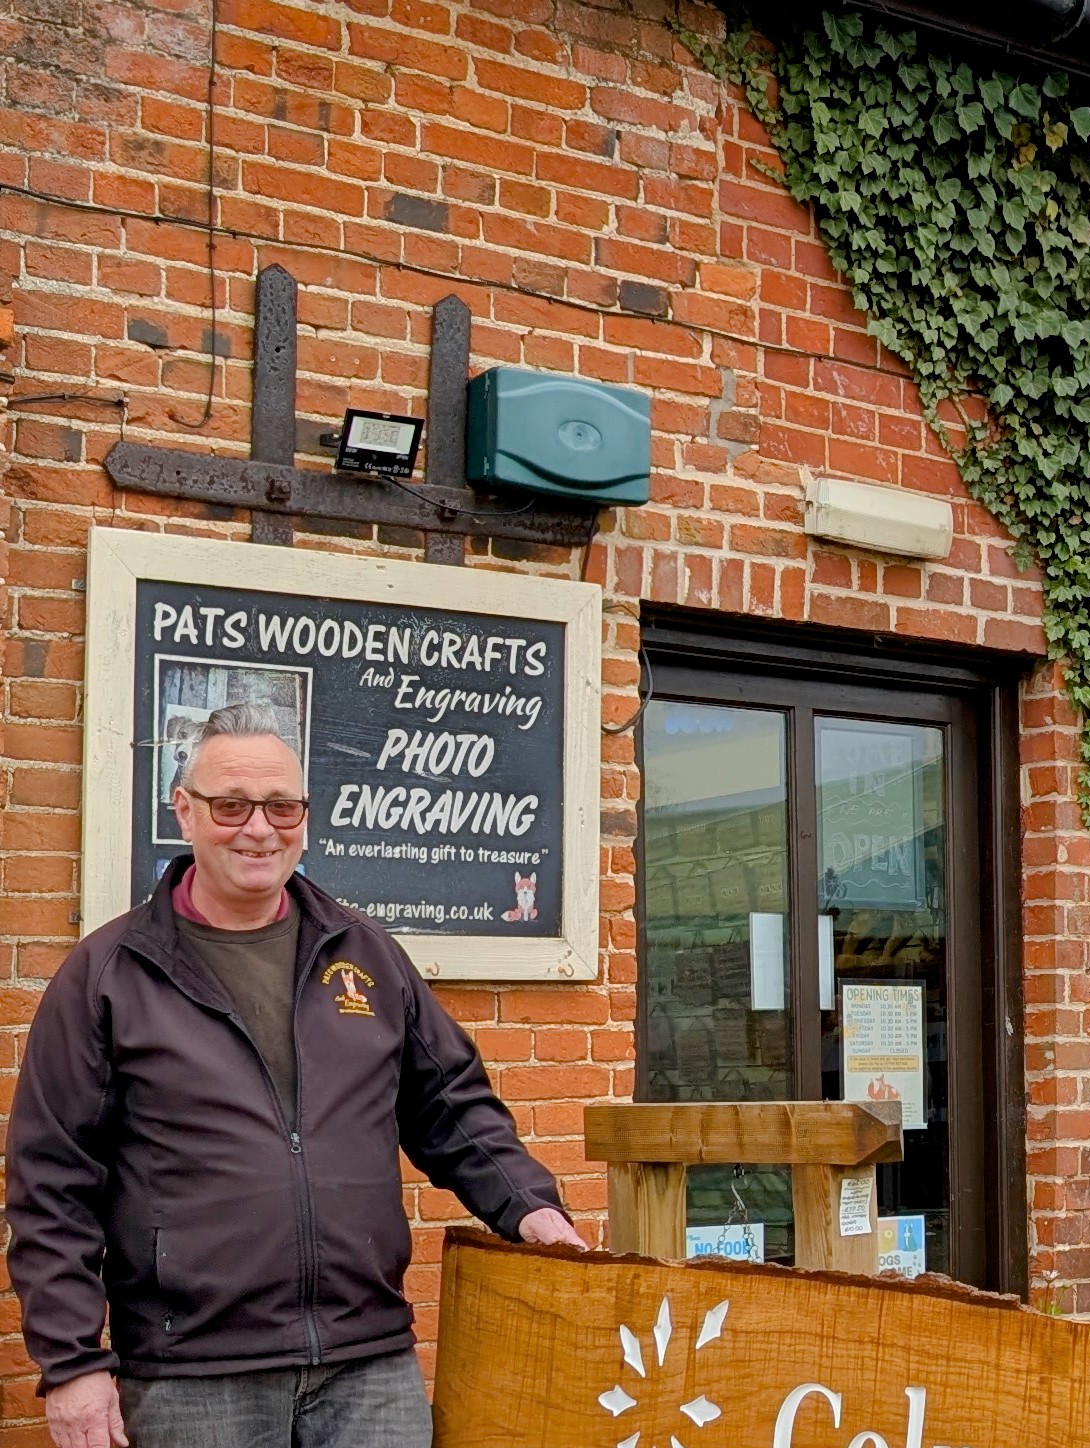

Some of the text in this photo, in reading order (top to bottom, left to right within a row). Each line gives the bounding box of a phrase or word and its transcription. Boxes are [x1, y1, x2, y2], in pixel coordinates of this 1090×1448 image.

[153, 602, 547, 676] PATS WOODEN CRAFTS
[359, 667, 543, 730] And Engraving
[376, 728, 495, 778] PHOTO
[330, 784, 539, 836] ENGRAVING
[348, 841, 428, 864] everlasting
[431, 844, 457, 864] gift
[459, 846, 475, 862] to
[824, 831, 912, 877] OPEN
[846, 988, 920, 1002] OPENING TIMES
[694, 1242, 713, 1255] NO
[878, 1254, 901, 1267] OGS
